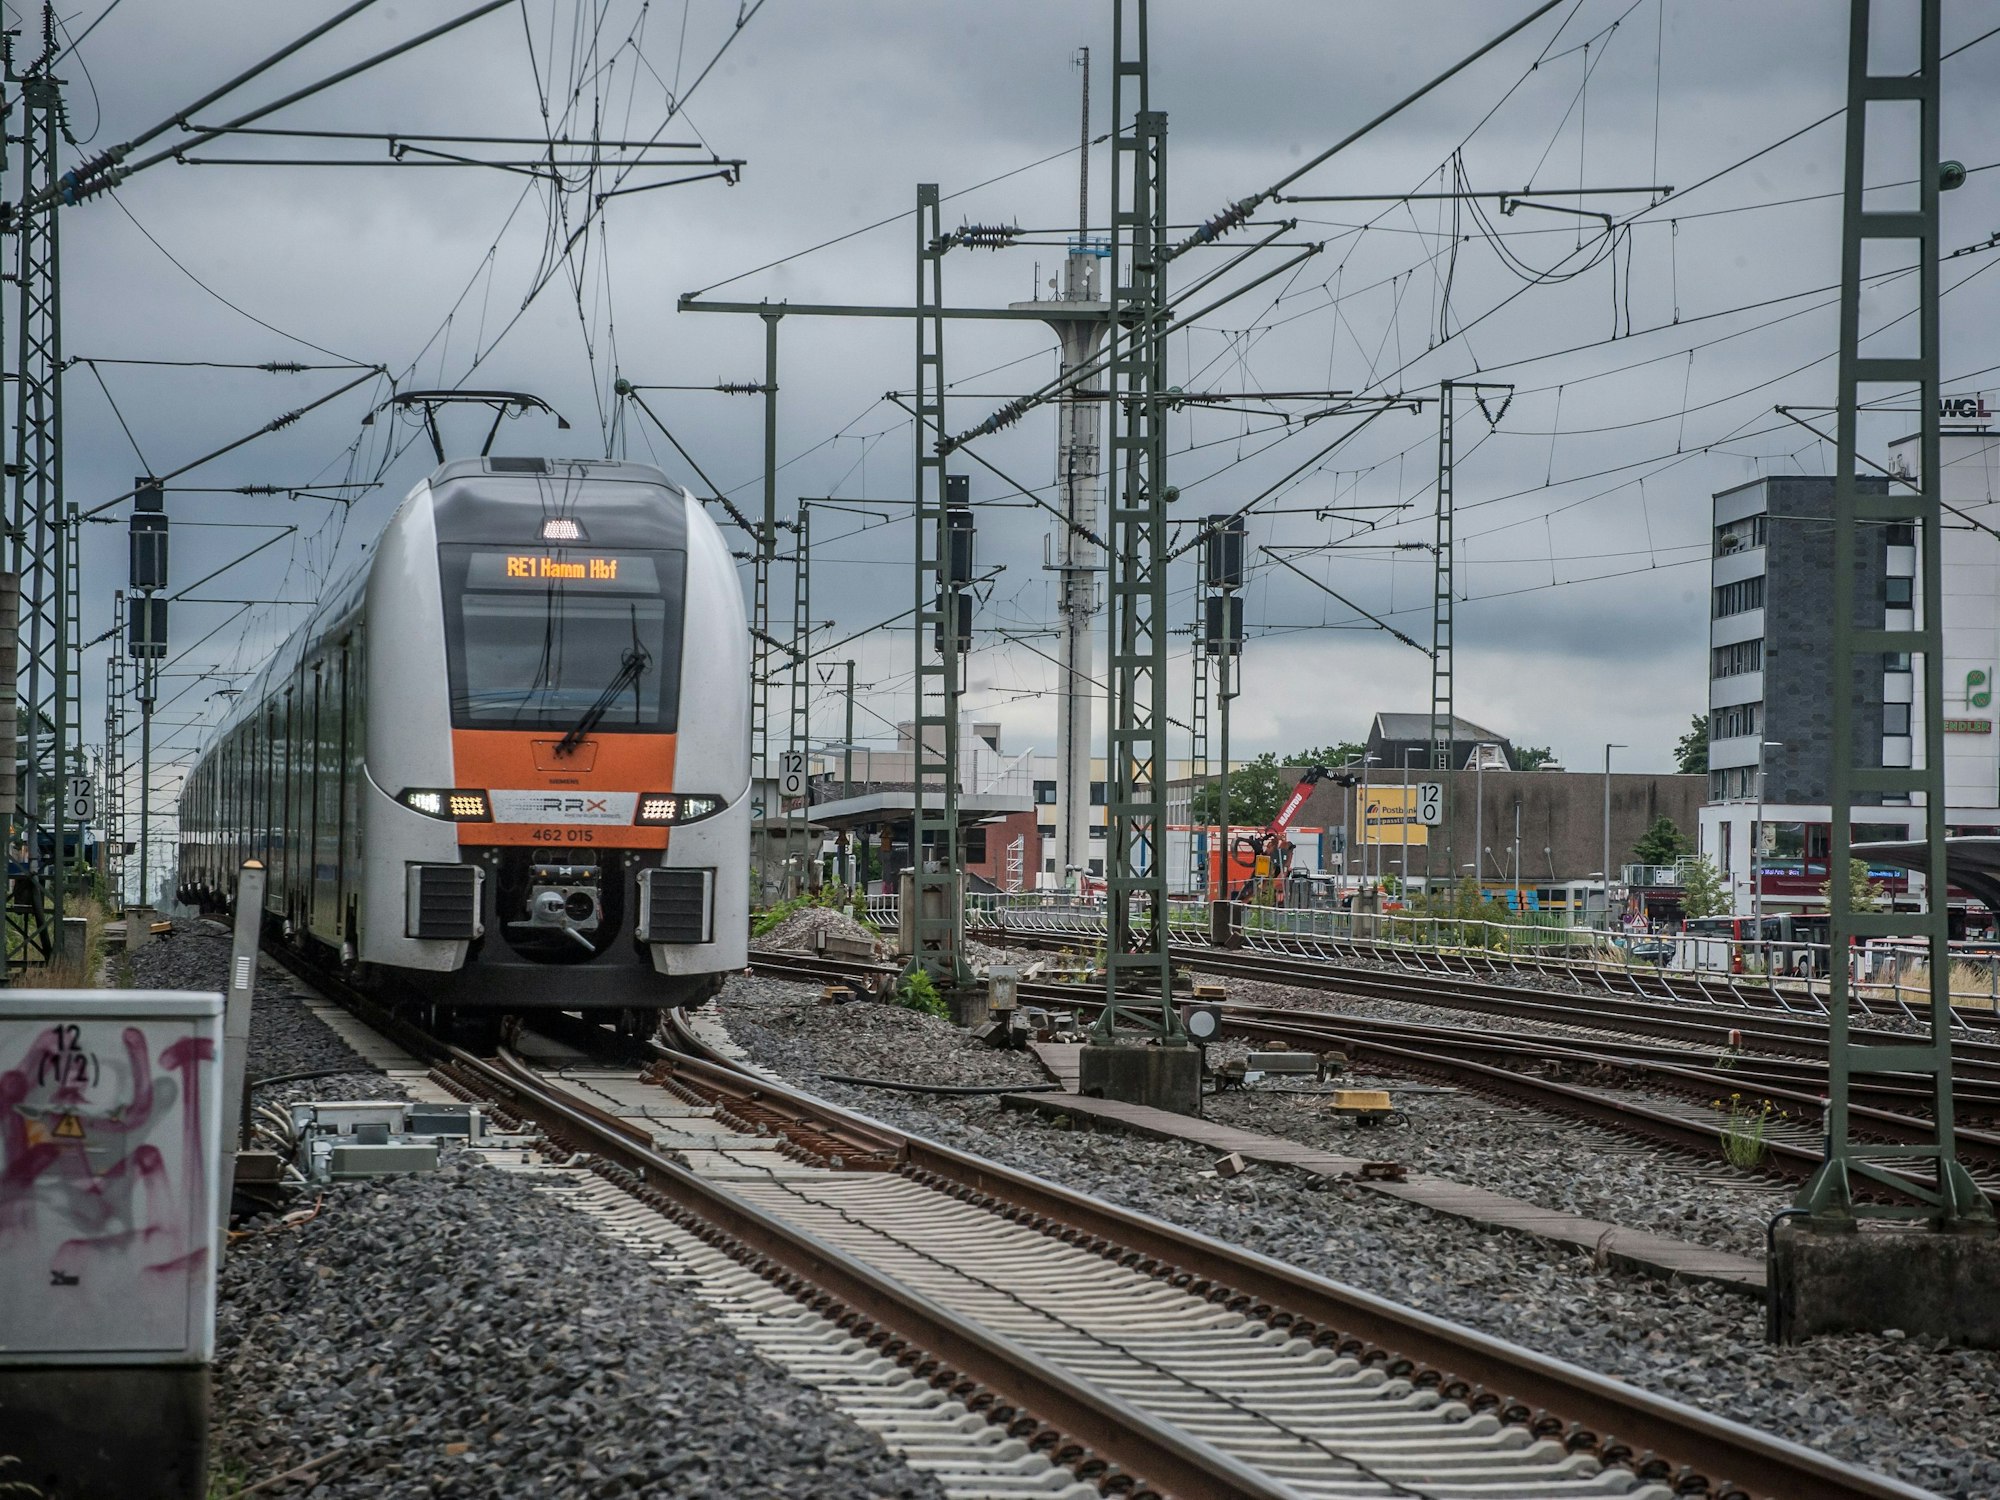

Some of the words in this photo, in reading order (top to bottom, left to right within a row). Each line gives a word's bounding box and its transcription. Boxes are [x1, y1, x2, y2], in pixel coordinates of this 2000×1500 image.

[1939, 398, 1992, 418] WGL
[507, 557, 536, 577] RE1
[540, 558, 585, 578] Hamm
[590, 559, 617, 579] Hbf
[1943, 721, 1991, 732] ENDLER
[784, 755, 802, 773] 12
[72, 780, 90, 797] 12
[786, 775, 799, 792] 0
[1421, 785, 1438, 802] 12
[74, 799, 88, 816] 0
[543, 798, 607, 812] RRX
[1278, 793, 1302, 826] MANITOU
[1382, 806, 1417, 814] Postbnk
[1423, 804, 1436, 820] 0
[532, 829, 562, 841] 462
[567, 829, 593, 842] 015
[52, 1023, 82, 1051] 12
[38, 1052, 100, 1088] (1/2)
